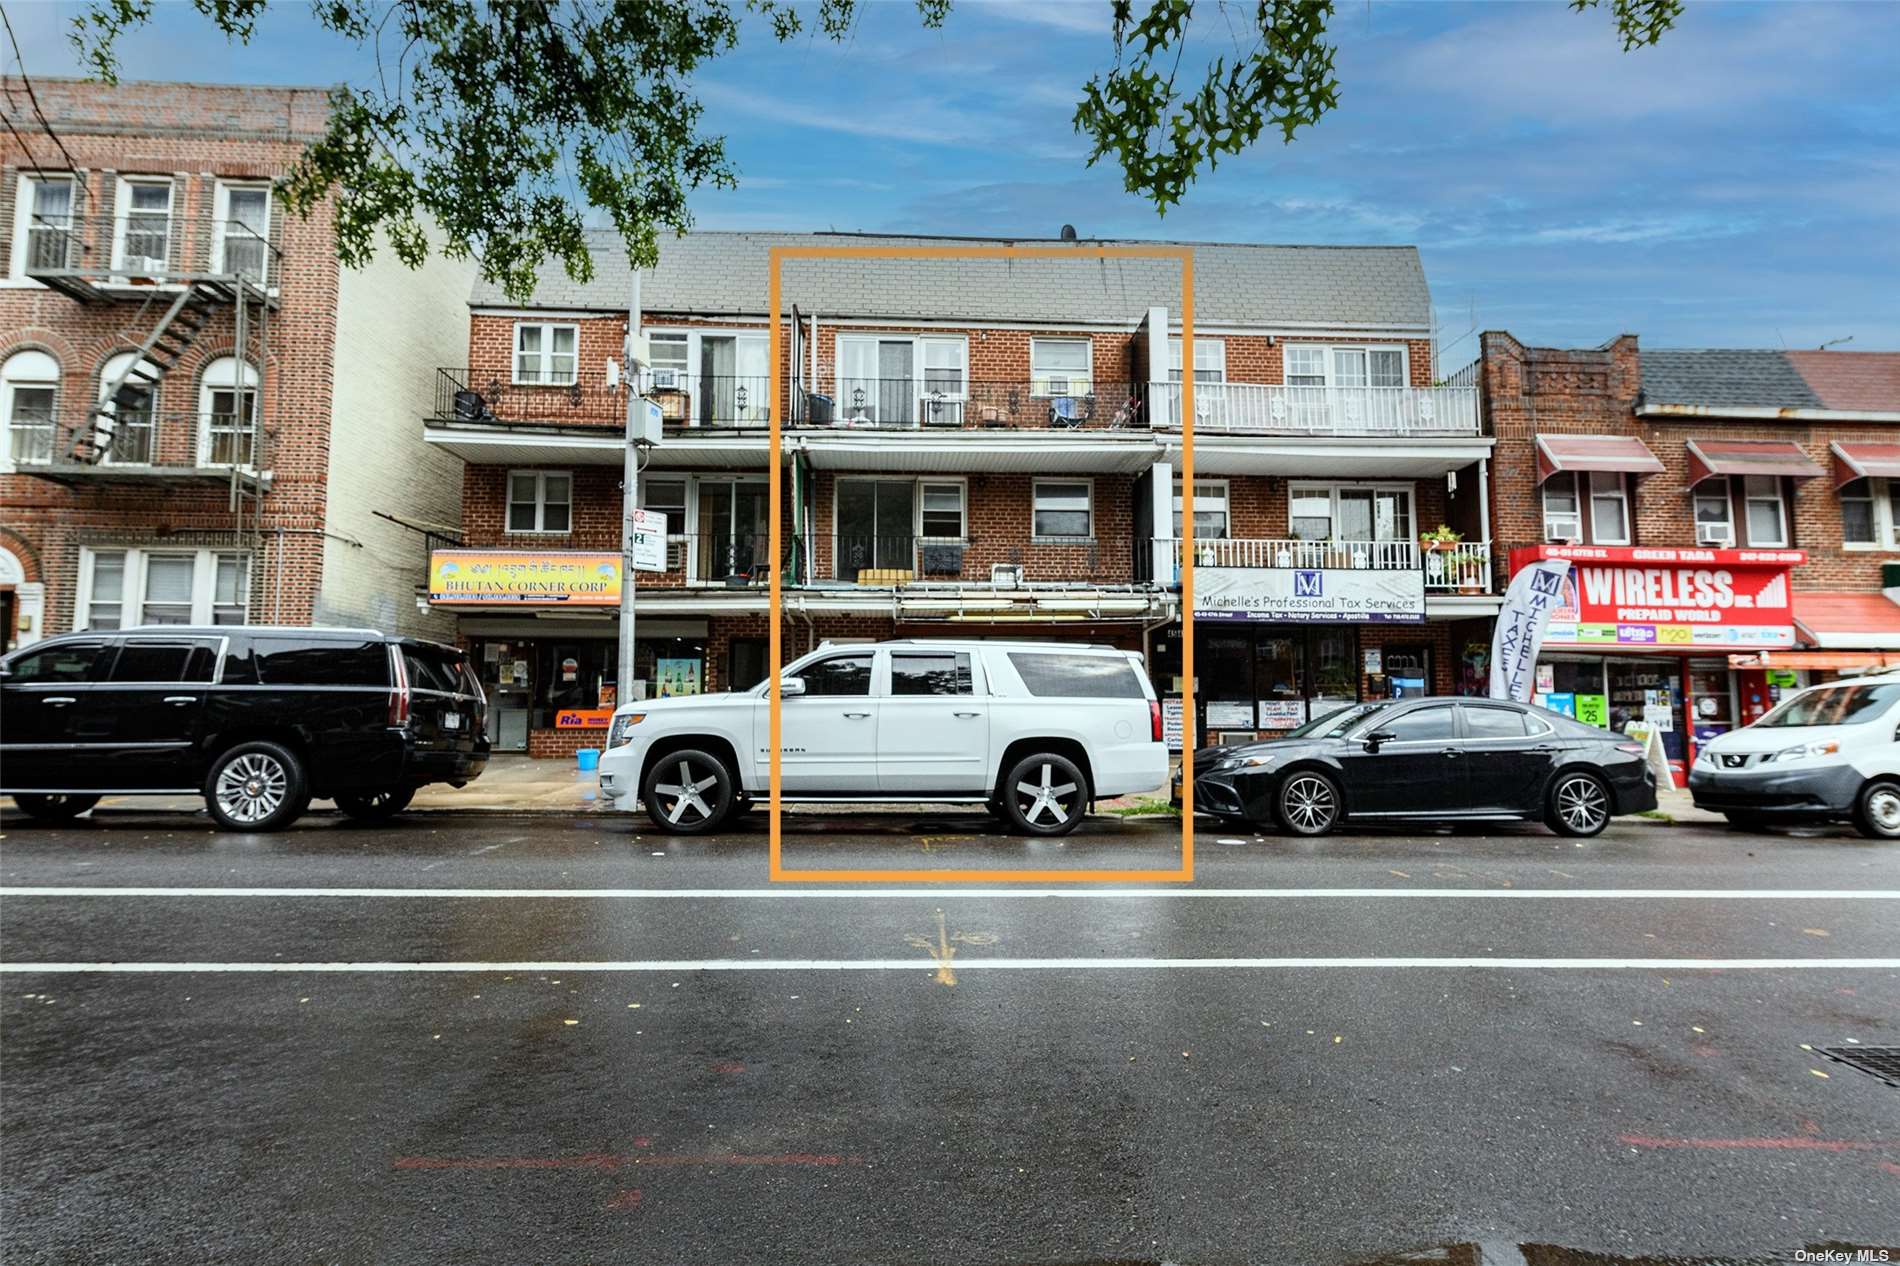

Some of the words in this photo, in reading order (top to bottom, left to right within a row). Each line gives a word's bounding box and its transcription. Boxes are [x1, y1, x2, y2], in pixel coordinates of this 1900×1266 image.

[1679, 551, 1716, 561] TARA
[446, 581, 503, 591] BHUTAN
[508, 581, 566, 592] CORNER
[569, 581, 607, 592] CORP
[1582, 567, 1734, 609] WIRELESS
[1202, 596, 1260, 607] Michelle's
[1263, 596, 1335, 608] Professional
[1339, 598, 1361, 608] Tax
[1365, 598, 1416, 609] Services
[1617, 609, 1672, 621] PREPAID
[1674, 610, 1722, 622] WORLD
[561, 713, 581, 725] Ria
